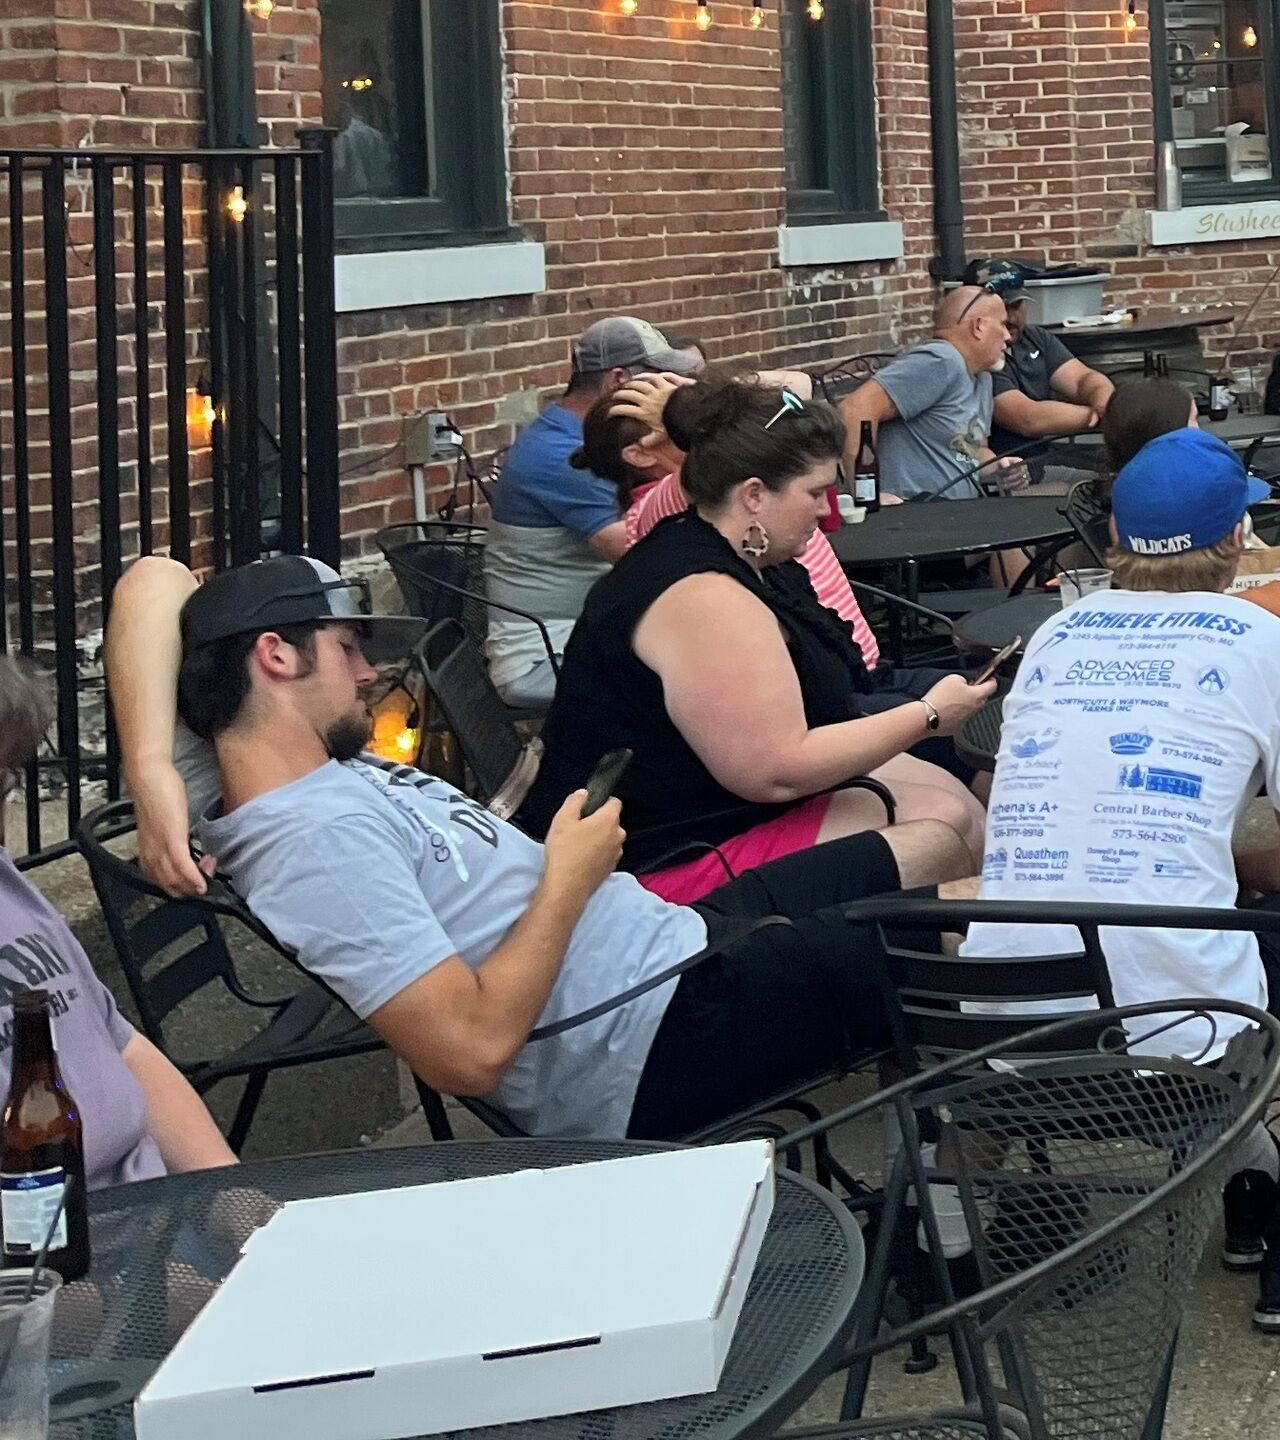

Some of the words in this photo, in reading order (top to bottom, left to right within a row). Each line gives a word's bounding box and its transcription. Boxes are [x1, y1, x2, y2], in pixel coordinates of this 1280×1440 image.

[1128, 533, 1192, 555] WILDCATS
[1229, 580, 1261, 591] HITE
[1068, 611, 1163, 629] ACHIEVE
[1158, 611, 1252, 636] FITNESS
[1069, 660, 1176, 671] ADVANCED
[1065, 670, 1172, 682] OUTCOMES
[1094, 803, 1138, 814] Central
[1142, 804, 1183, 819] Barber
[1184, 811, 1212, 828] Shop
[1051, 860, 1068, 869] LLC
